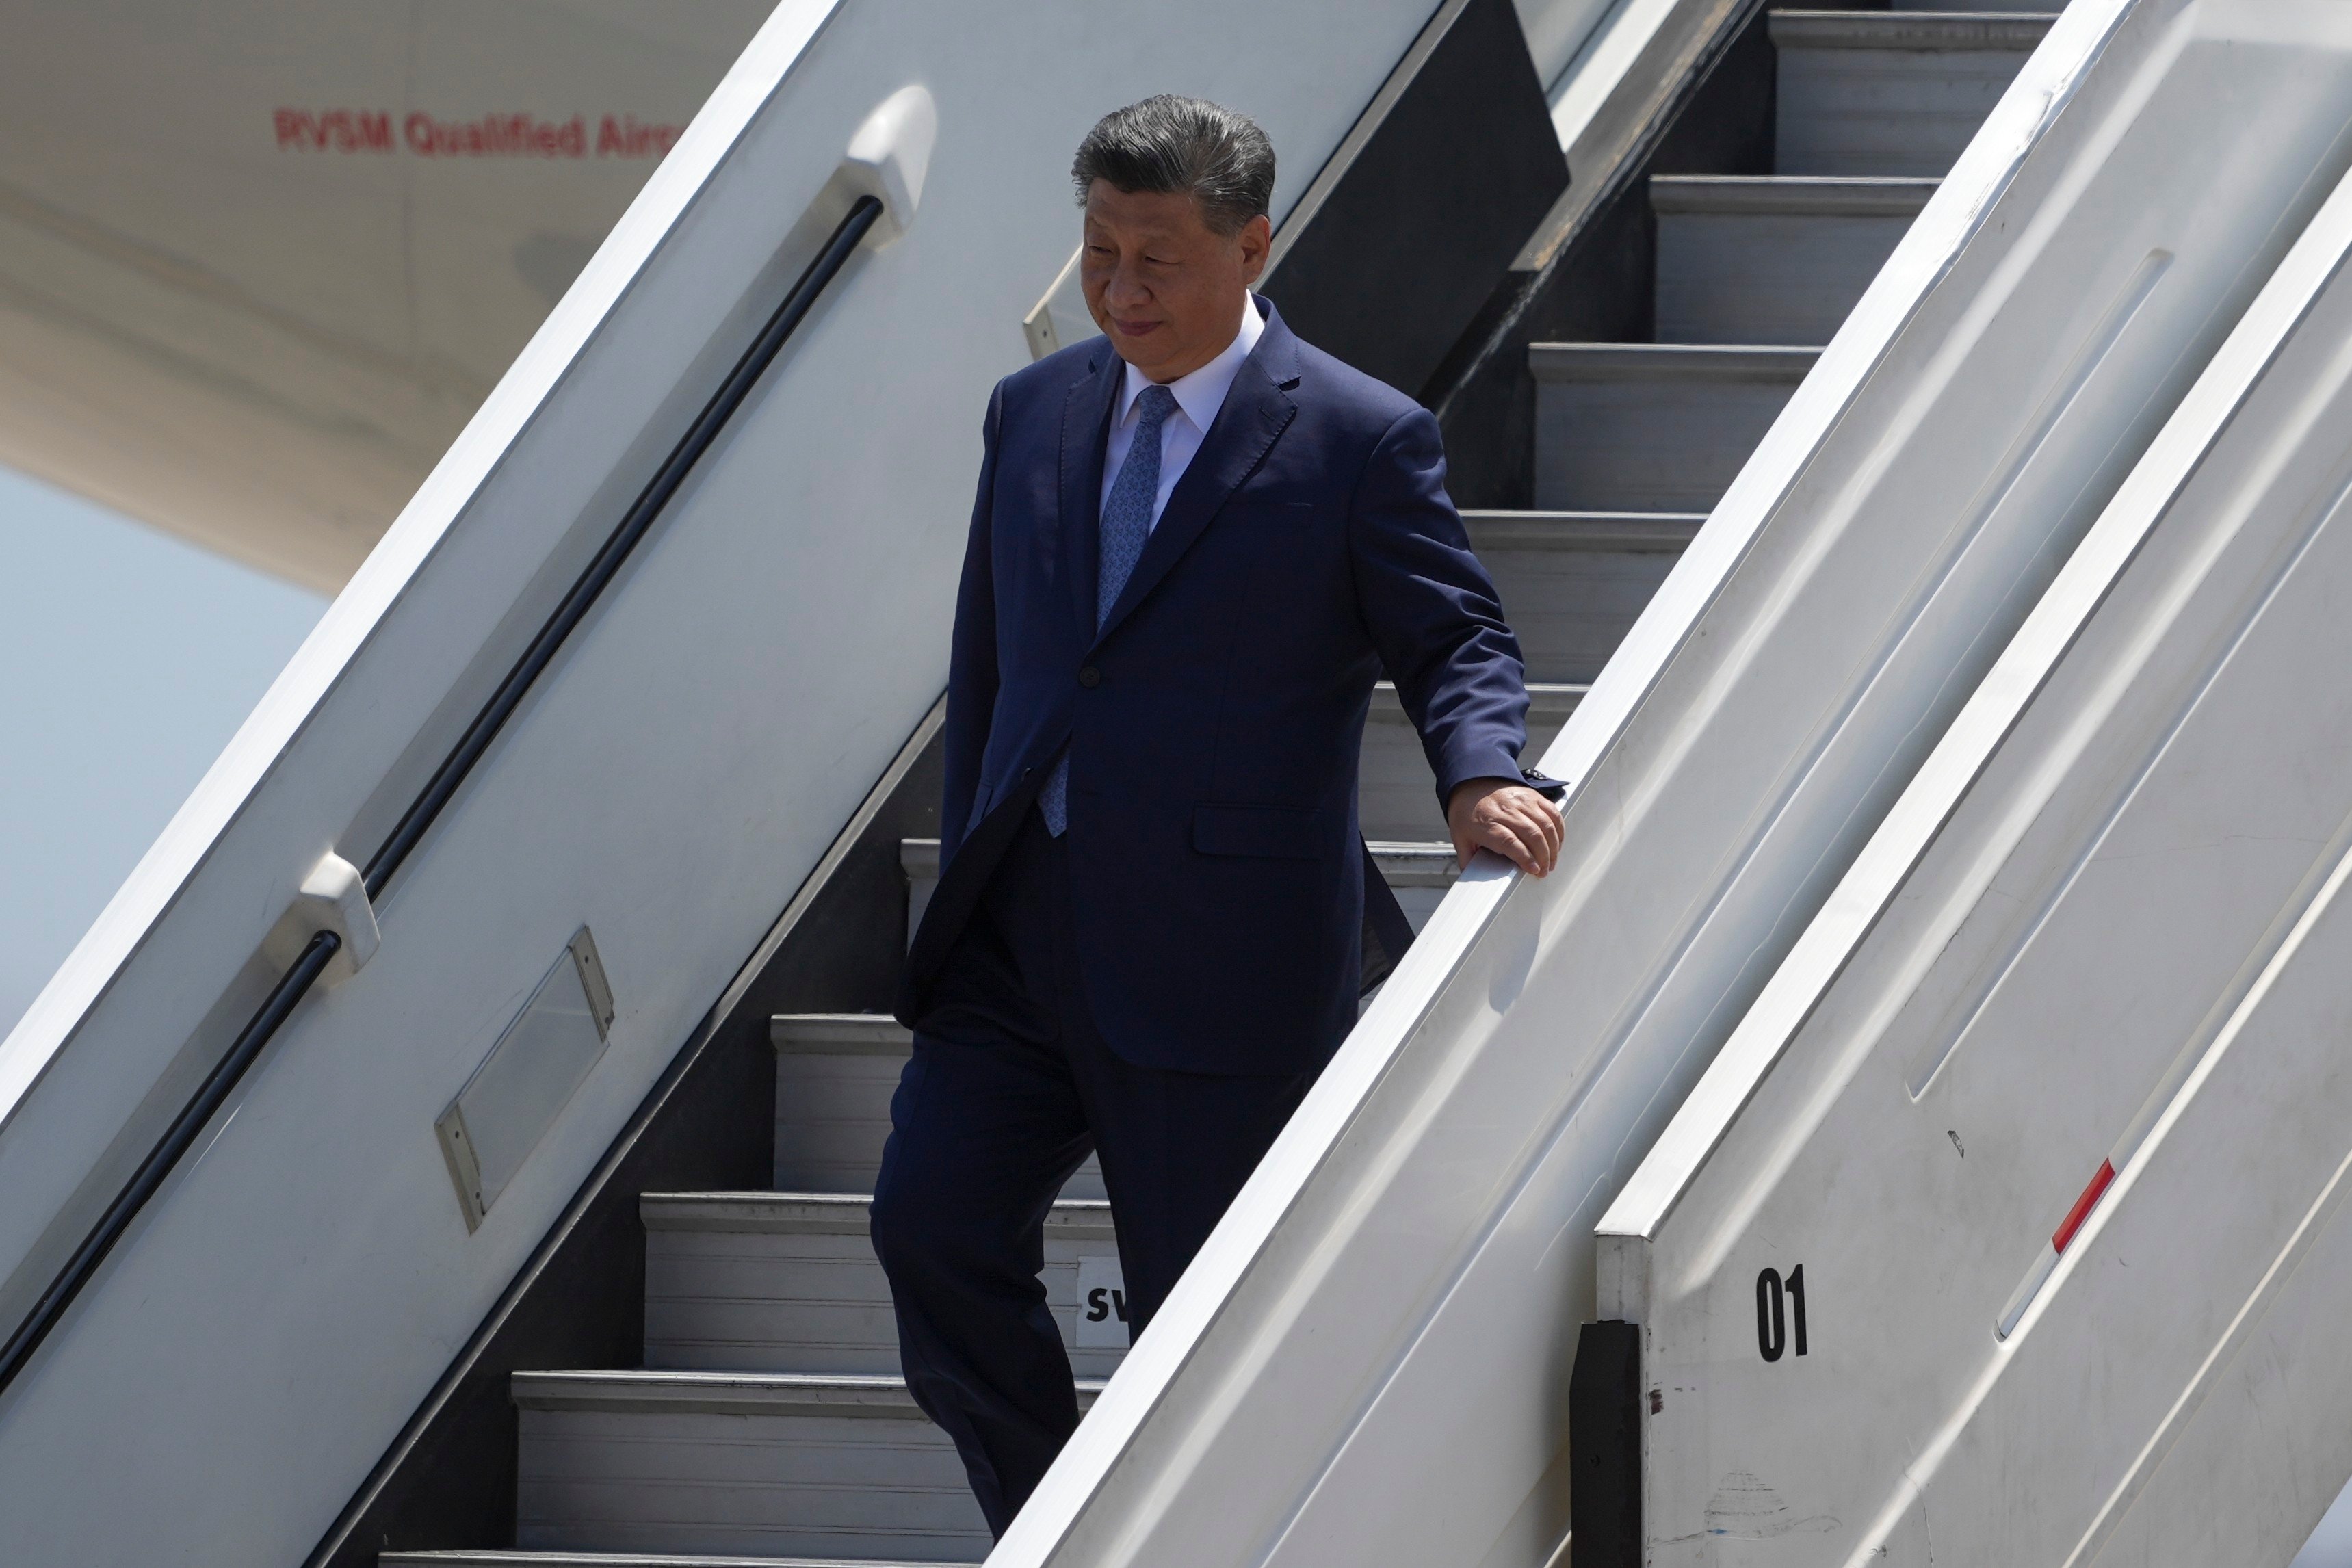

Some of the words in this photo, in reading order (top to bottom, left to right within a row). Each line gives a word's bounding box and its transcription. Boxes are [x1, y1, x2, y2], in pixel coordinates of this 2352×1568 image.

[274, 107, 395, 155] RVSM
[404, 111, 587, 157] Qualified
[1756, 1264, 1807, 1363] 01
